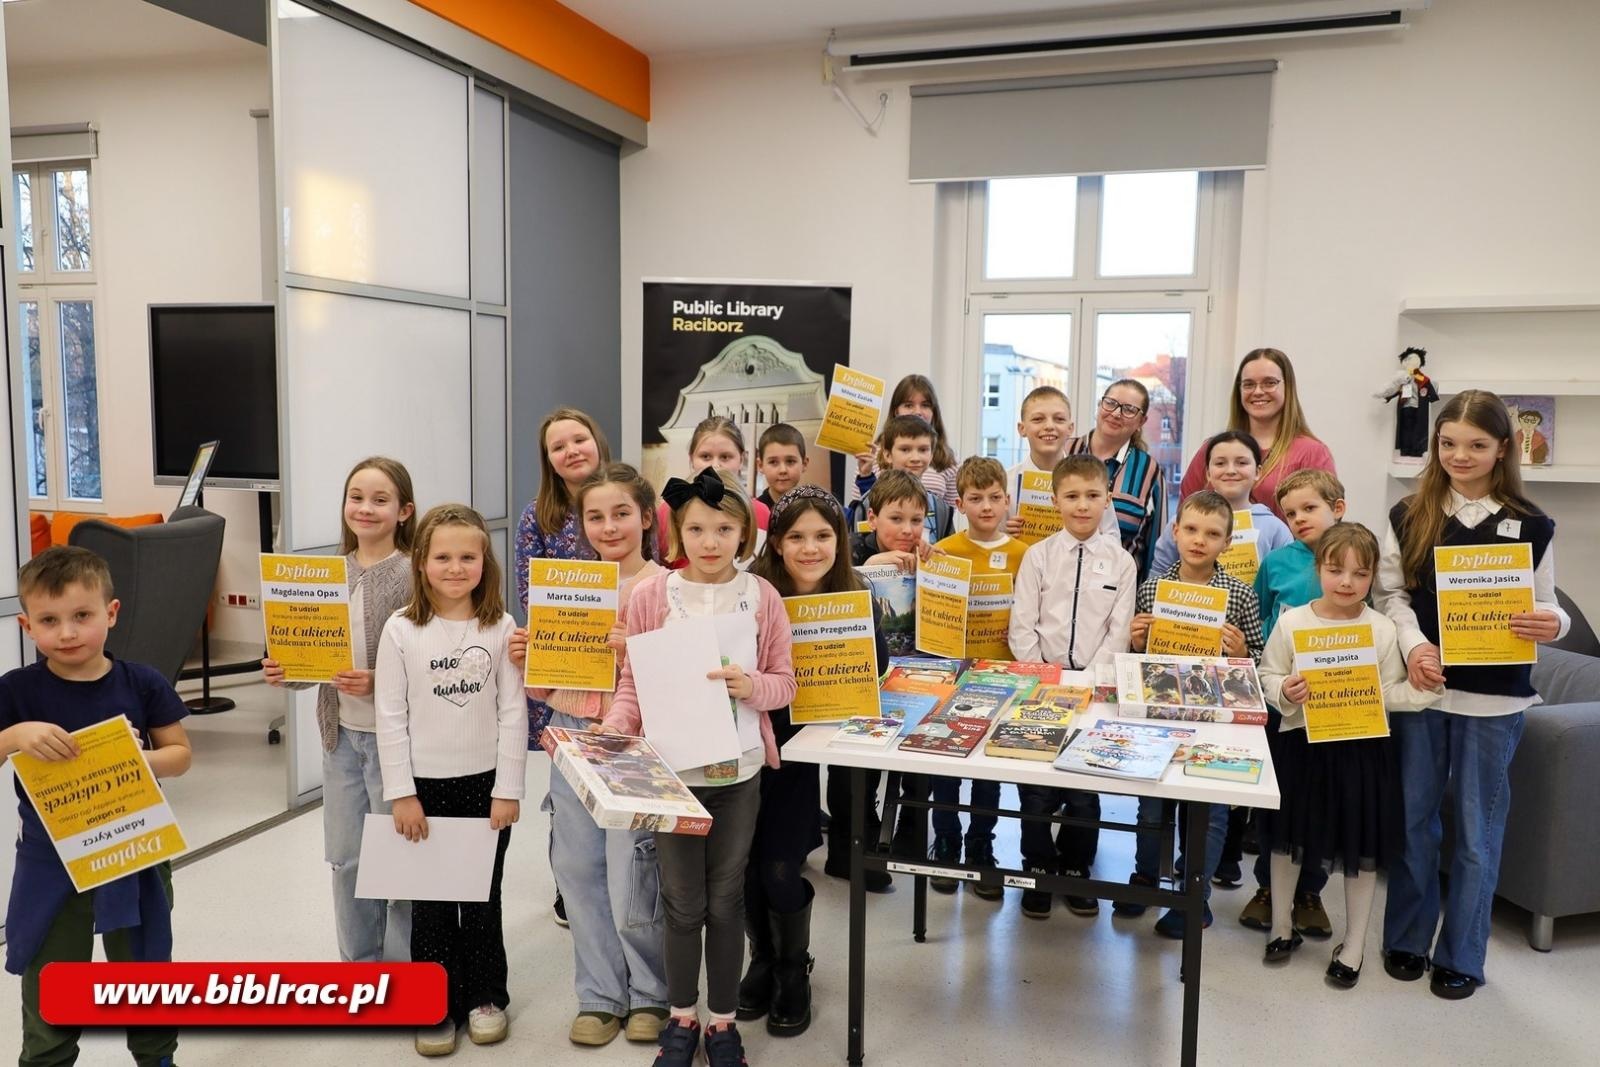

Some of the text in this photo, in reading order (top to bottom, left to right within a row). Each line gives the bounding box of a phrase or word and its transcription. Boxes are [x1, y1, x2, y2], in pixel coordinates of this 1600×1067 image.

[672, 300, 784, 320] Public Library
[672, 317, 744, 333] Raciborz
[829, 410, 842, 420] Kot
[843, 415, 875, 431] Cukierek
[1033, 477, 1053, 490] Dyp
[924, 558, 961, 576] Dyplom
[1452, 551, 1513, 569] Dyplom
[275, 563, 330, 580] Dyplom
[545, 567, 603, 585] Dyplom
[970, 581, 1000, 593] plom
[1449, 575, 1520, 585] Weronika Jasita
[271, 588, 339, 599] Magdalena Opas
[546, 592, 602, 603] Marta Sulska
[1167, 588, 1215, 605] Dyplom
[298, 605, 320, 613] udział
[567, 610, 589, 618] udział
[797, 601, 855, 619] Dyplom
[921, 605, 932, 614] Kot
[933, 609, 963, 624] Cukierek
[1160, 607, 1218, 624] Władysław Stopa
[1446, 610, 1513, 622] Kot Cukier
[271, 625, 346, 638] Kot Cukierek
[535, 629, 556, 641] Kot
[791, 624, 867, 637] Milena Przegendza
[1445, 624, 1493, 632] Waldemara
[270, 638, 348, 648] Waldemara Cichonia
[823, 642, 846, 650] udział
[1153, 637, 1171, 649] Kot
[1172, 640, 1217, 657] Cukierek
[1307, 632, 1360, 649] Dyplom
[533, 642, 612, 655] Waldemara Cichonia
[430, 657, 459, 670] one
[1314, 653, 1359, 664] Kinga Jasita
[794, 661, 871, 678] Kot Cukierek
[1333, 669, 1353, 677] udział
[433, 679, 481, 696] number
[840, 676, 874, 685] Cichonia
[1308, 686, 1377, 701] Kot Cukierek
[1307, 698, 1380, 710] Waldemara Cichonia
[35, 758, 139, 799] Waldemara Cichonia
[44, 769, 141, 813] Kot Cukierek
[86, 805, 127, 825] Za udział
[82, 818, 145, 847] Adam Kyrcz
[90, 835, 162, 872] Dyplom
